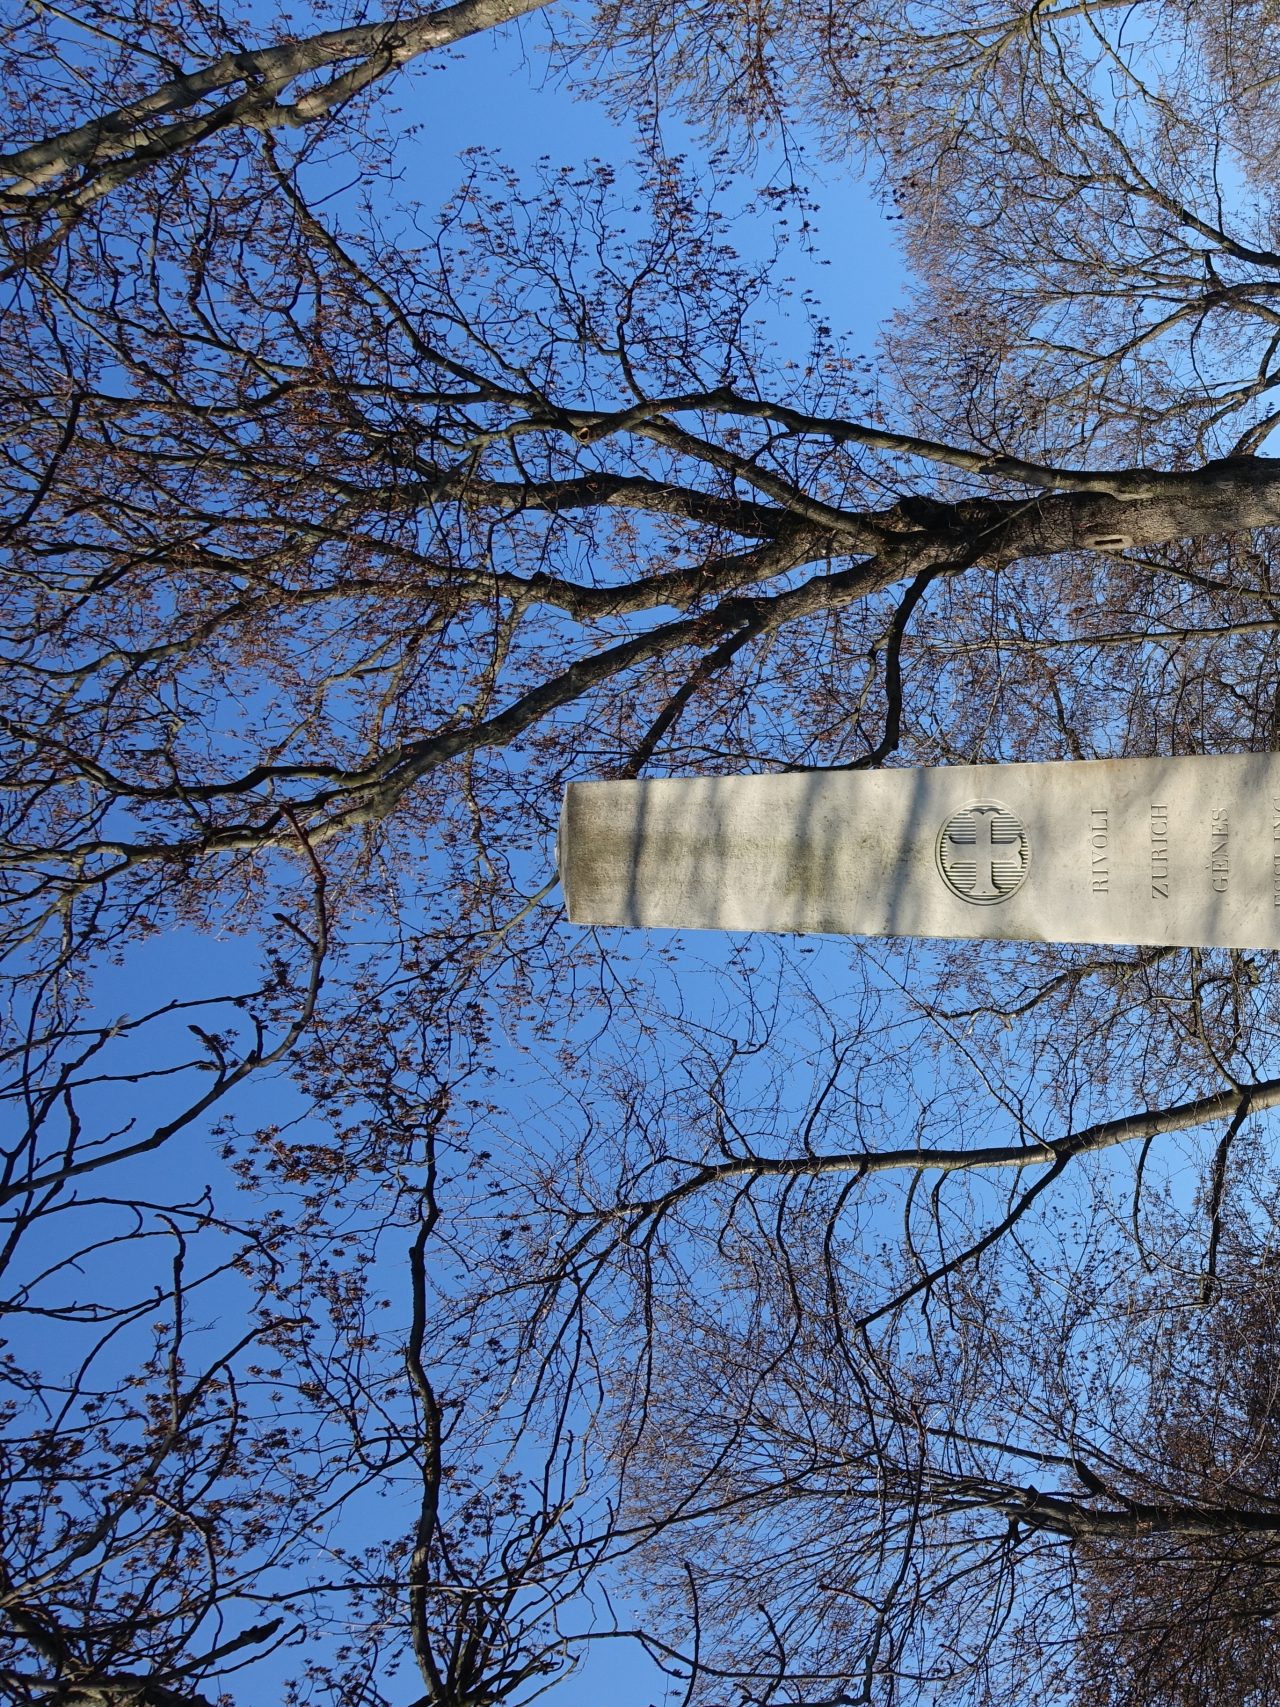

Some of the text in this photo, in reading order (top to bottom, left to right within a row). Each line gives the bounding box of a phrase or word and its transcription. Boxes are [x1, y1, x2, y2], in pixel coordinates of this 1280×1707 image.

[1091, 807, 1109, 895] RIVOLI
[1151, 804, 1169, 899] ZURICH
[1205, 807, 1229, 894] GÈNES
